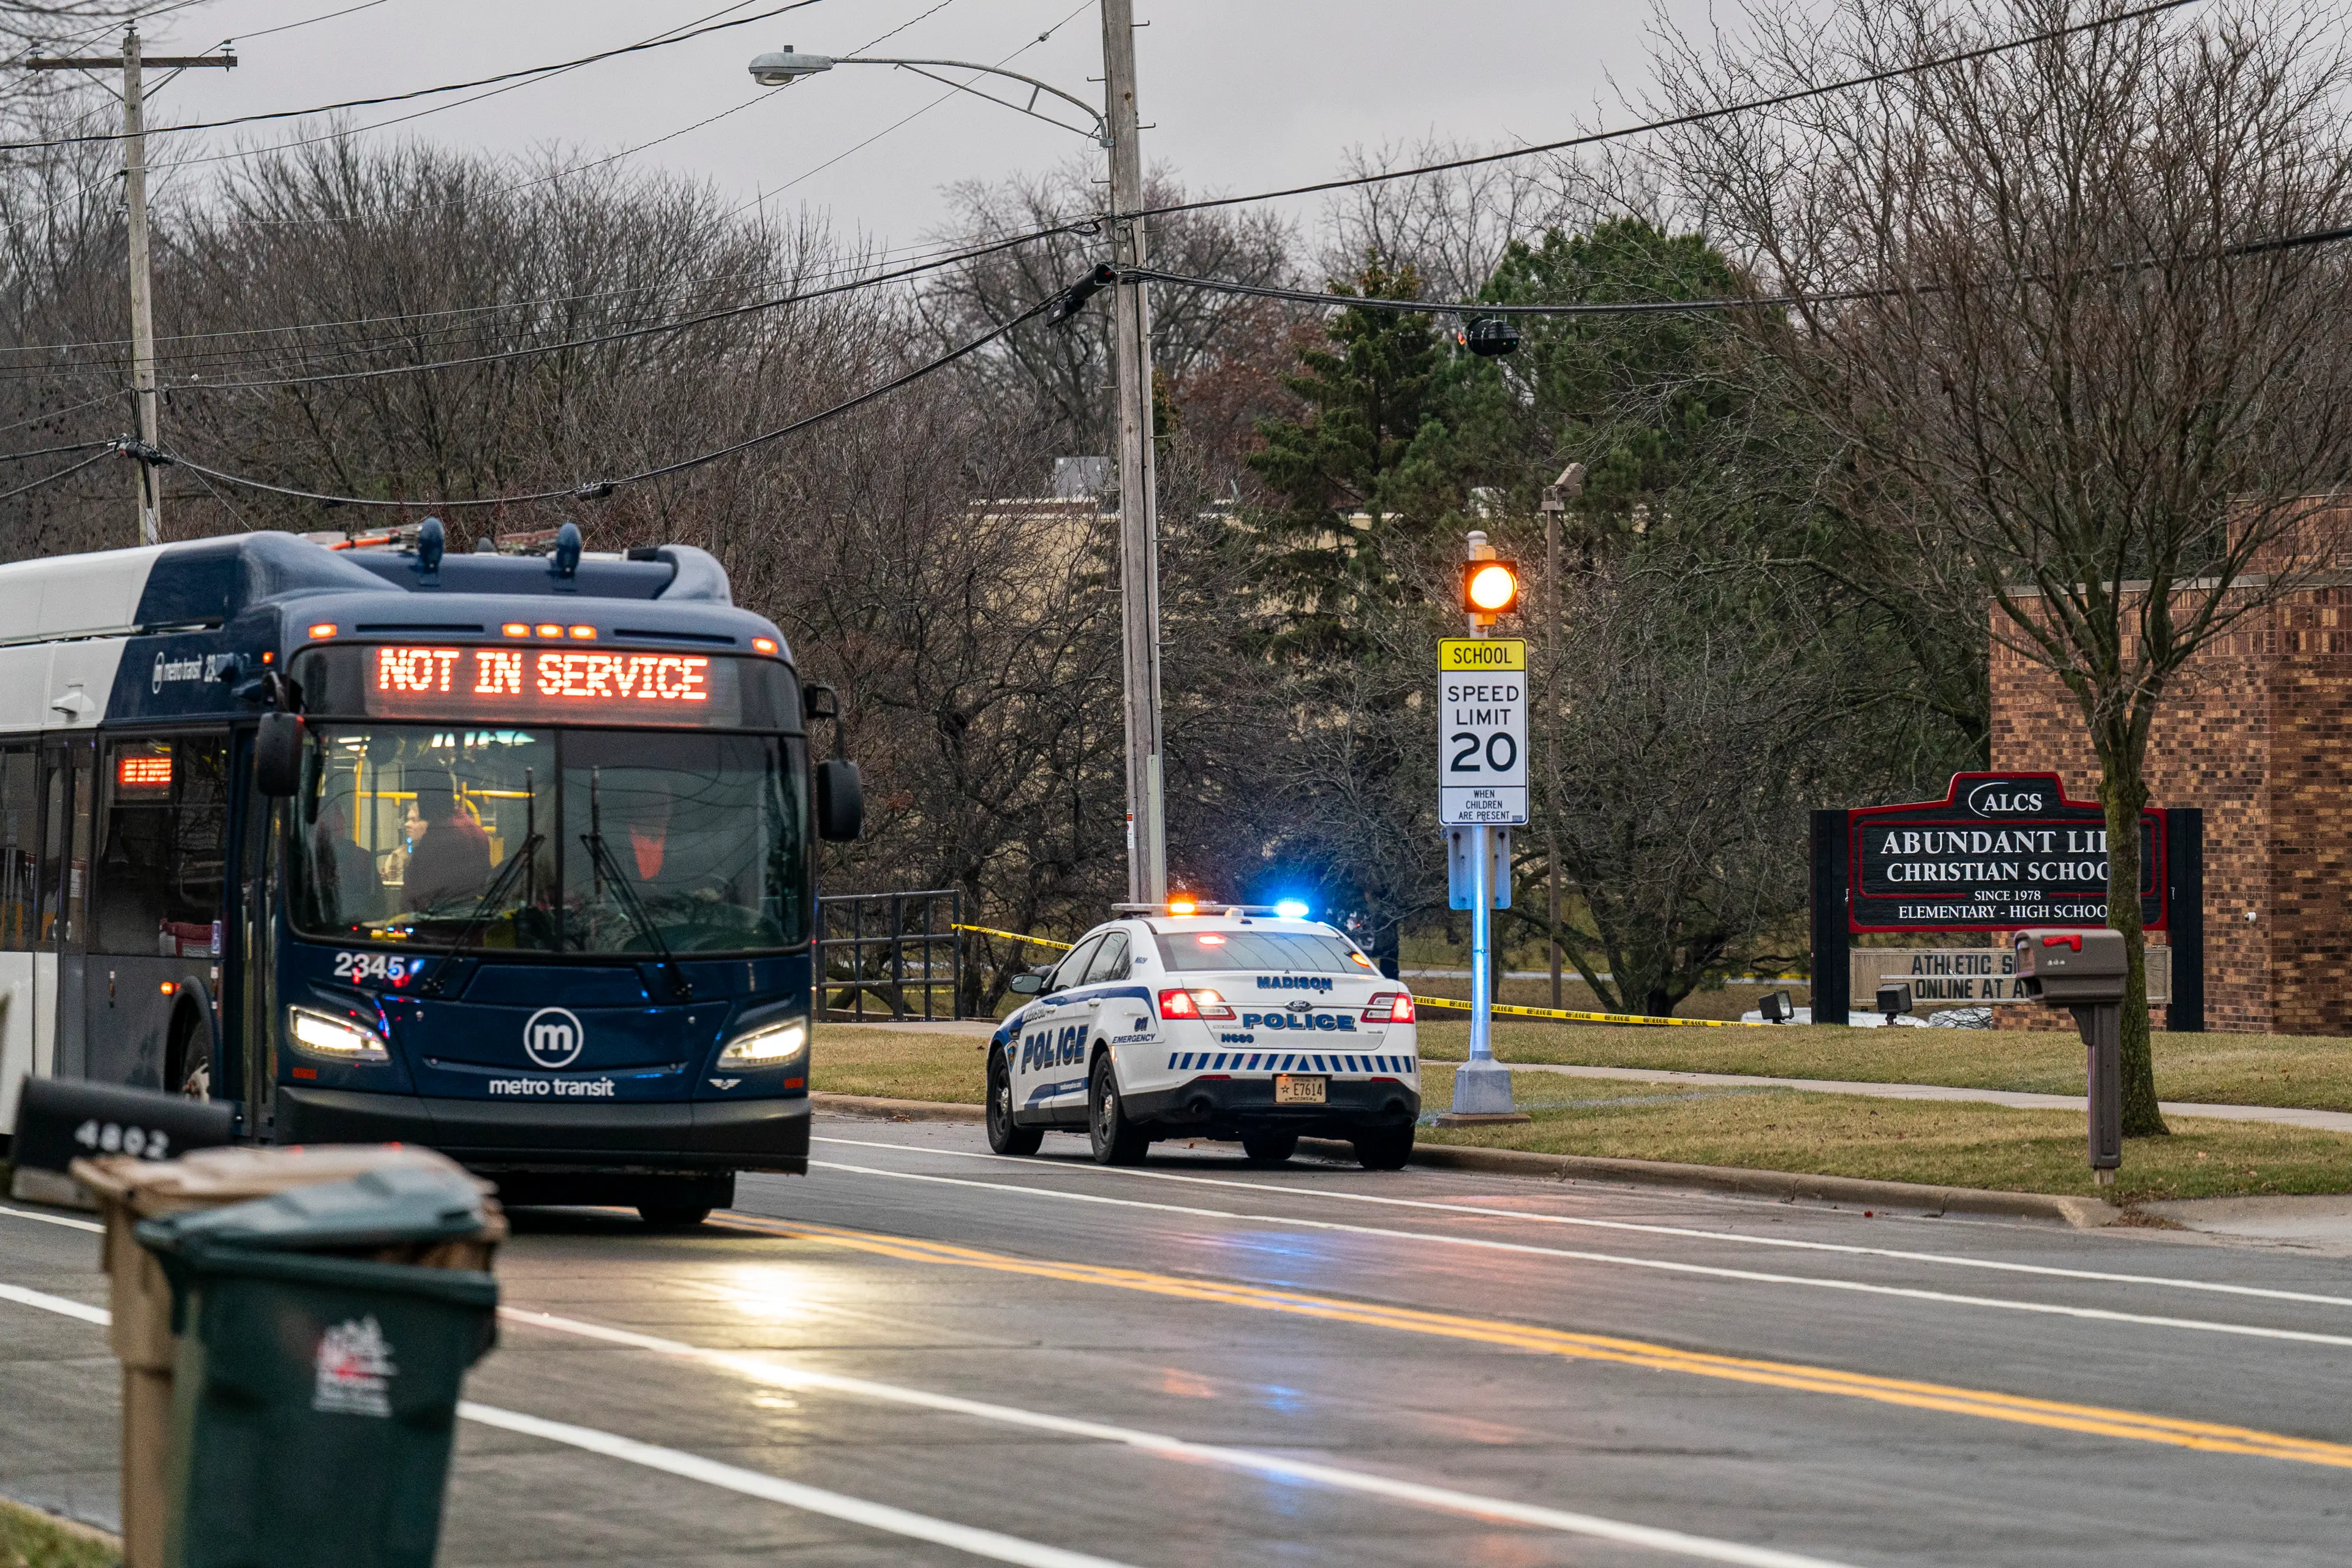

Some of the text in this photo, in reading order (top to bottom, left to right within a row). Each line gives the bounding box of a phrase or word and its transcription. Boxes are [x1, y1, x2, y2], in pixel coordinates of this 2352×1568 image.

[1453, 647, 1512, 664] SCHOOL
[379, 648, 709, 700] NOT IN SERVICE
[1447, 685, 1519, 702] SPEED
[1456, 709, 1511, 725] LIMIT
[1450, 732, 1517, 772] 20
[1466, 801, 1502, 809] CHILDREN
[1982, 793, 2043, 812] ALCS
[1458, 811, 1510, 820] ARE PRESENT
[1880, 831, 2056, 854] ABUNDANT
[1887, 861, 2108, 882] CHRISTIAN SCHOO
[1974, 891, 2041, 901] SINCE 1978
[1899, 905, 1997, 919] ELEMENTARY
[2010, 905, 2050, 918] HIGH
[2054, 905, 2108, 918] SCHOO
[334, 952, 405, 981] 2345
[1912, 955, 1991, 975] ATHLETIC
[1257, 976, 1333, 990] MADISON
[1915, 978, 1973, 999] ONLINE
[1981, 978, 2003, 999] AT
[1243, 1013, 1357, 1032] POLICE
[533, 1023, 574, 1051] m
[1112, 1033, 1156, 1044] EMERGENCY
[1021, 1023, 1090, 1076] POLICE
[489, 1076, 616, 1097] metro transit
[1294, 1083, 1322, 1096] E7614
[74, 1118, 170, 1160] 4802
